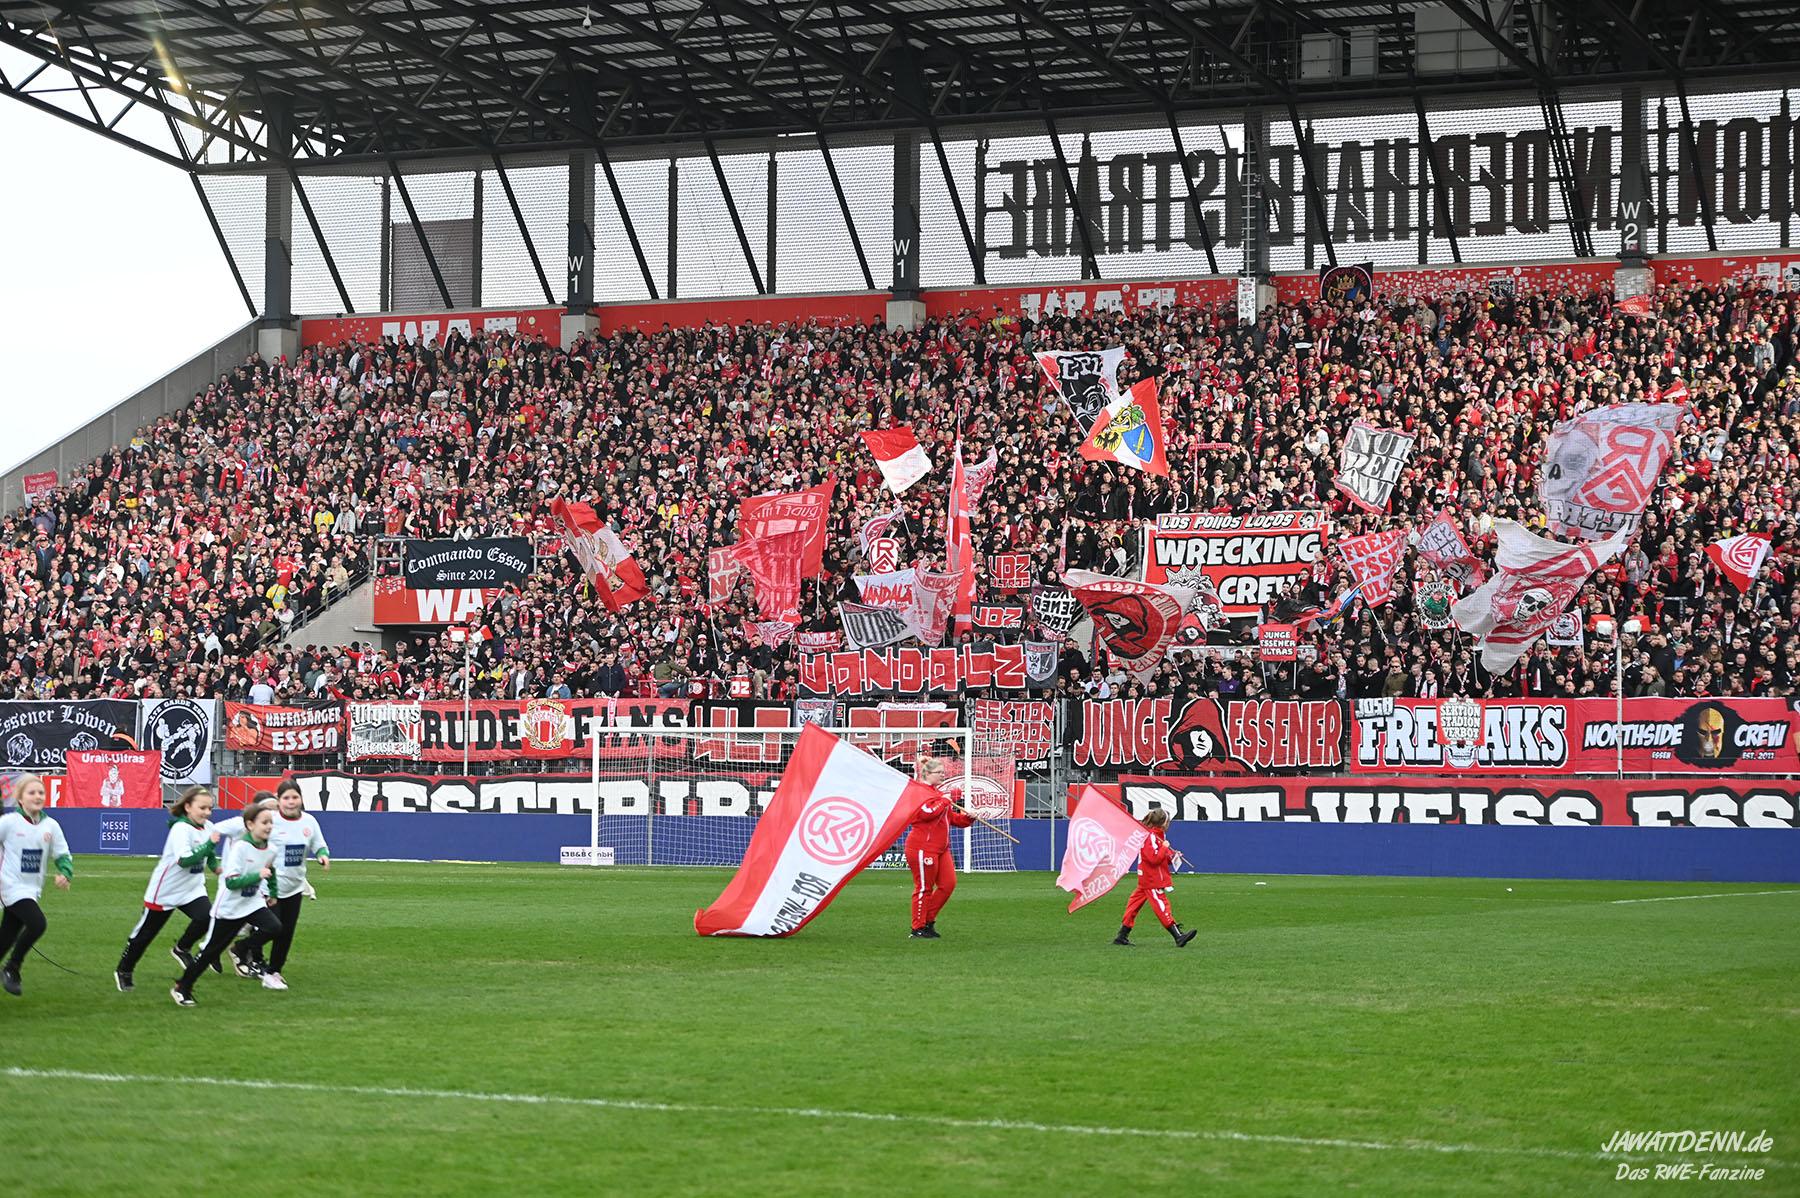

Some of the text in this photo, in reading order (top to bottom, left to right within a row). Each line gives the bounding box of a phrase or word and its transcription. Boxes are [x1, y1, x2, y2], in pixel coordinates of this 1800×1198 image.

[1622, 201, 1641, 220] W
[1624, 225, 1639, 244] 2
[894, 239, 911, 256] W
[568, 256, 584, 272] W
[898, 259, 906, 278] 1
[571, 275, 579, 293] 1
[1161, 515, 1192, 531] LOS
[1245, 512, 1295, 529] LOCOS
[1155, 532, 1322, 567] WRECKING
[408, 546, 528, 574] Commando Essen
[436, 568, 496, 582] Since 2012
[1263, 631, 1291, 640] JUNGE
[976, 699, 1056, 722] SEKTION
[1440, 705, 1480, 717] SEKTION
[60, 704, 117, 738] Löwen
[422, 704, 690, 751] RUDE FANS
[272, 724, 339, 751] ESSEN
[1074, 698, 1344, 768] JUNGE ESSENER
[1359, 705, 1567, 767] FREAKS
[1584, 722, 1788, 749] NORTHSIDE CREW
[102, 820, 129, 831] MESSE
[101, 831, 129, 842] ESSEN
